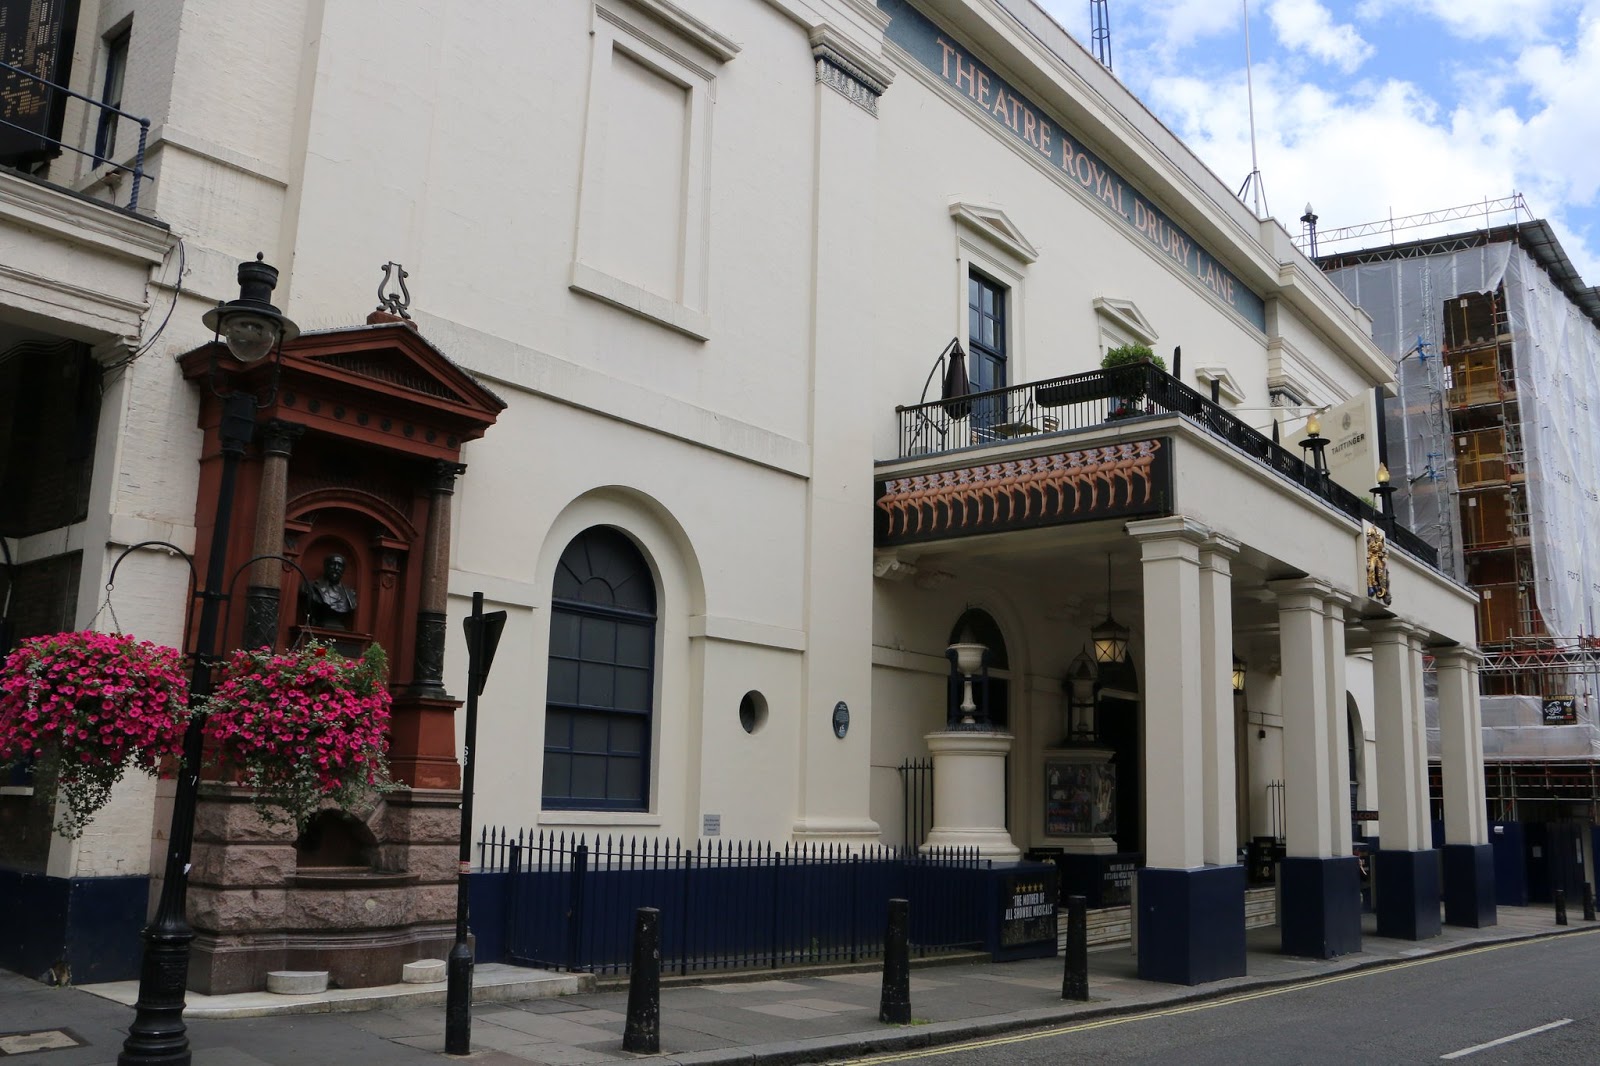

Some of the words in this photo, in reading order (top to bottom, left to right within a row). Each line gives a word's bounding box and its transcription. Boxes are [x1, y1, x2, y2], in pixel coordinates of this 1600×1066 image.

[936, 36, 1052, 158] THEATRE
[1062, 138, 1128, 218] ROYAL
[1134, 197, 1191, 268] DRURY
[1196, 250, 1236, 305] LANE
[1331, 433, 1365, 454] TAITTINGER
[1022, 893, 1039, 906] MOTHER
[1039, 892, 1045, 904] OF
[1005, 908, 1013, 920] ALL
[1013, 906, 1033, 919] SHOWBIZ
